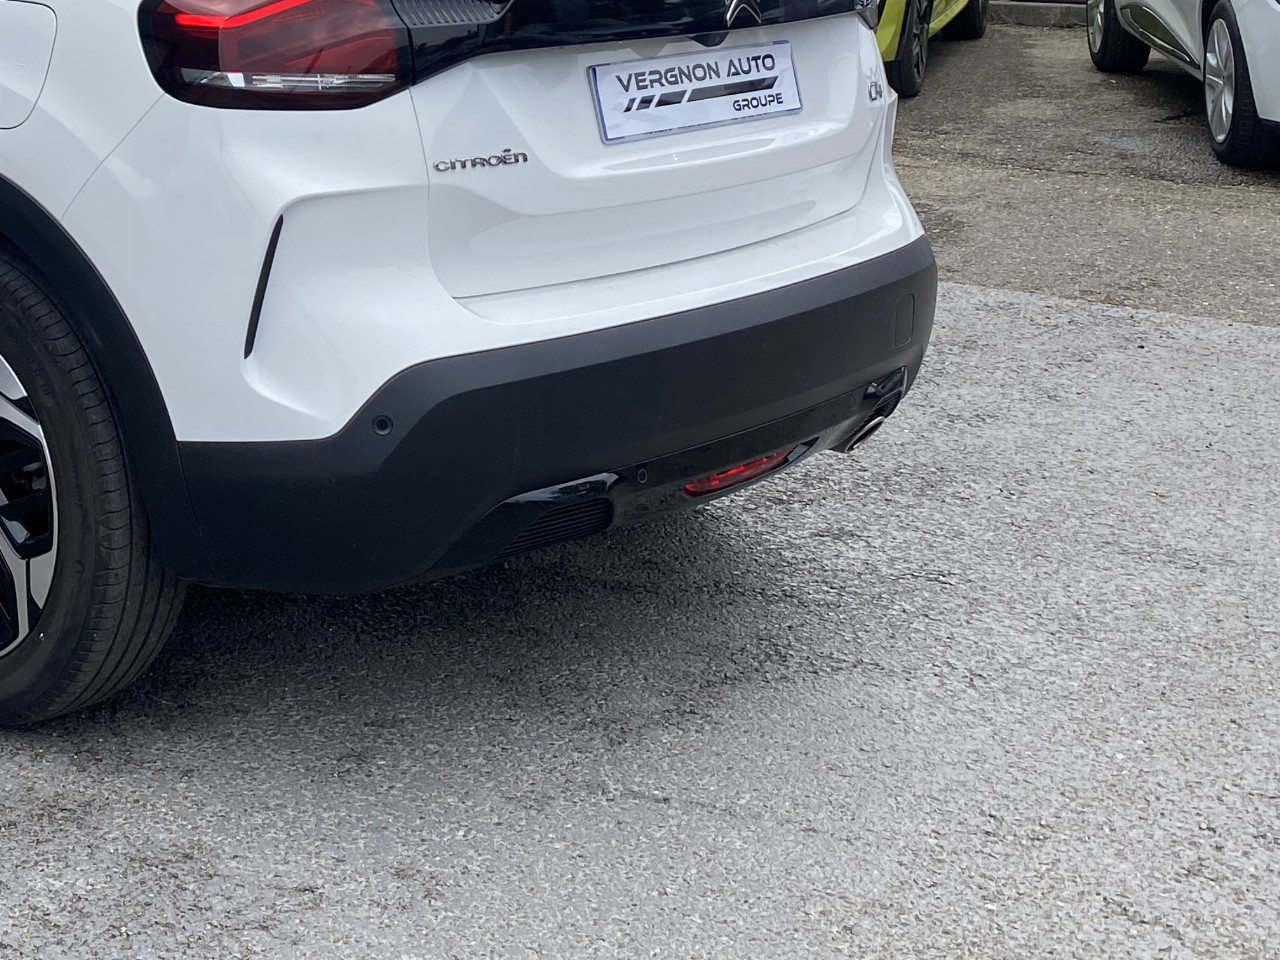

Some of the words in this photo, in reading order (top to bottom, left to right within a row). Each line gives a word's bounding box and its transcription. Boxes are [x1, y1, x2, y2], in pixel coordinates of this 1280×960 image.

[615, 60, 721, 93] VERGNON
[726, 53, 777, 78] AUTO
[732, 91, 784, 112] GROUPE
